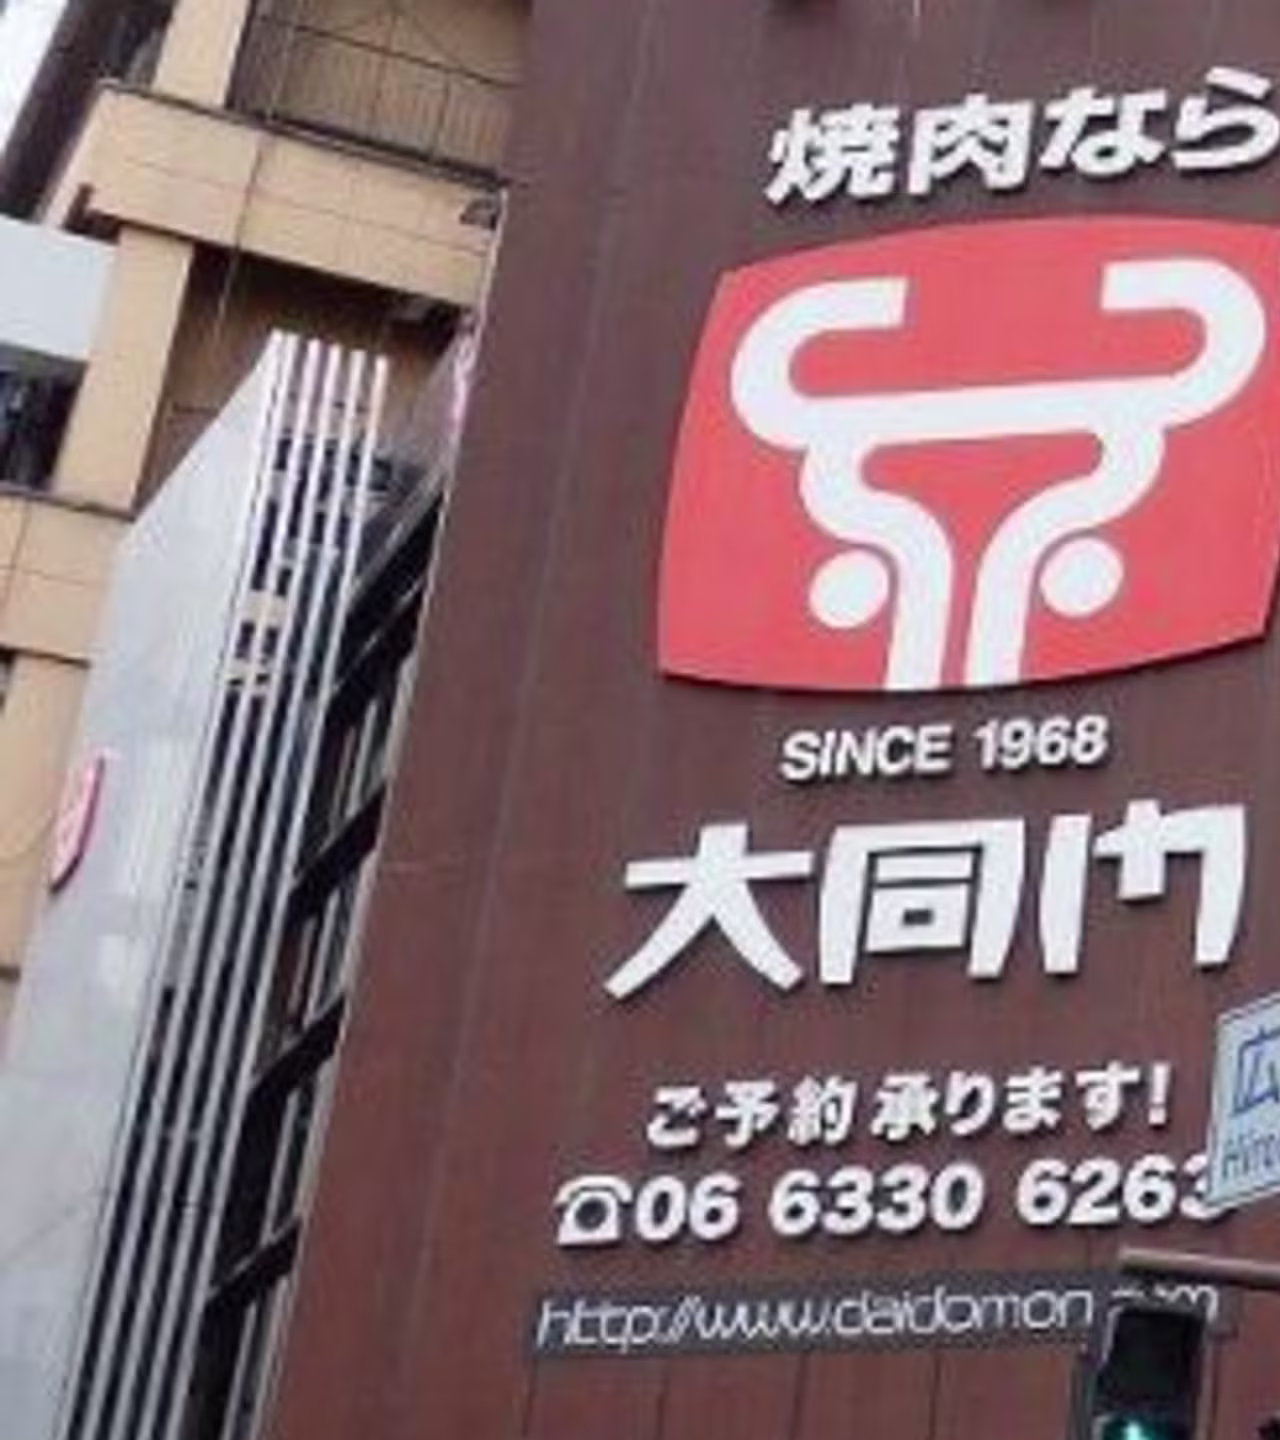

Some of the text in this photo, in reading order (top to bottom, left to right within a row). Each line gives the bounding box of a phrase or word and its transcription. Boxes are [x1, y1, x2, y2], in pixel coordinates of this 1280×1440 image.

[781, 715, 1109, 781] SINCE 1968
[604, 799, 1247, 999] 大同門
[634, 1176, 739, 1243] 06
[768, 1164, 983, 1237] 6330
